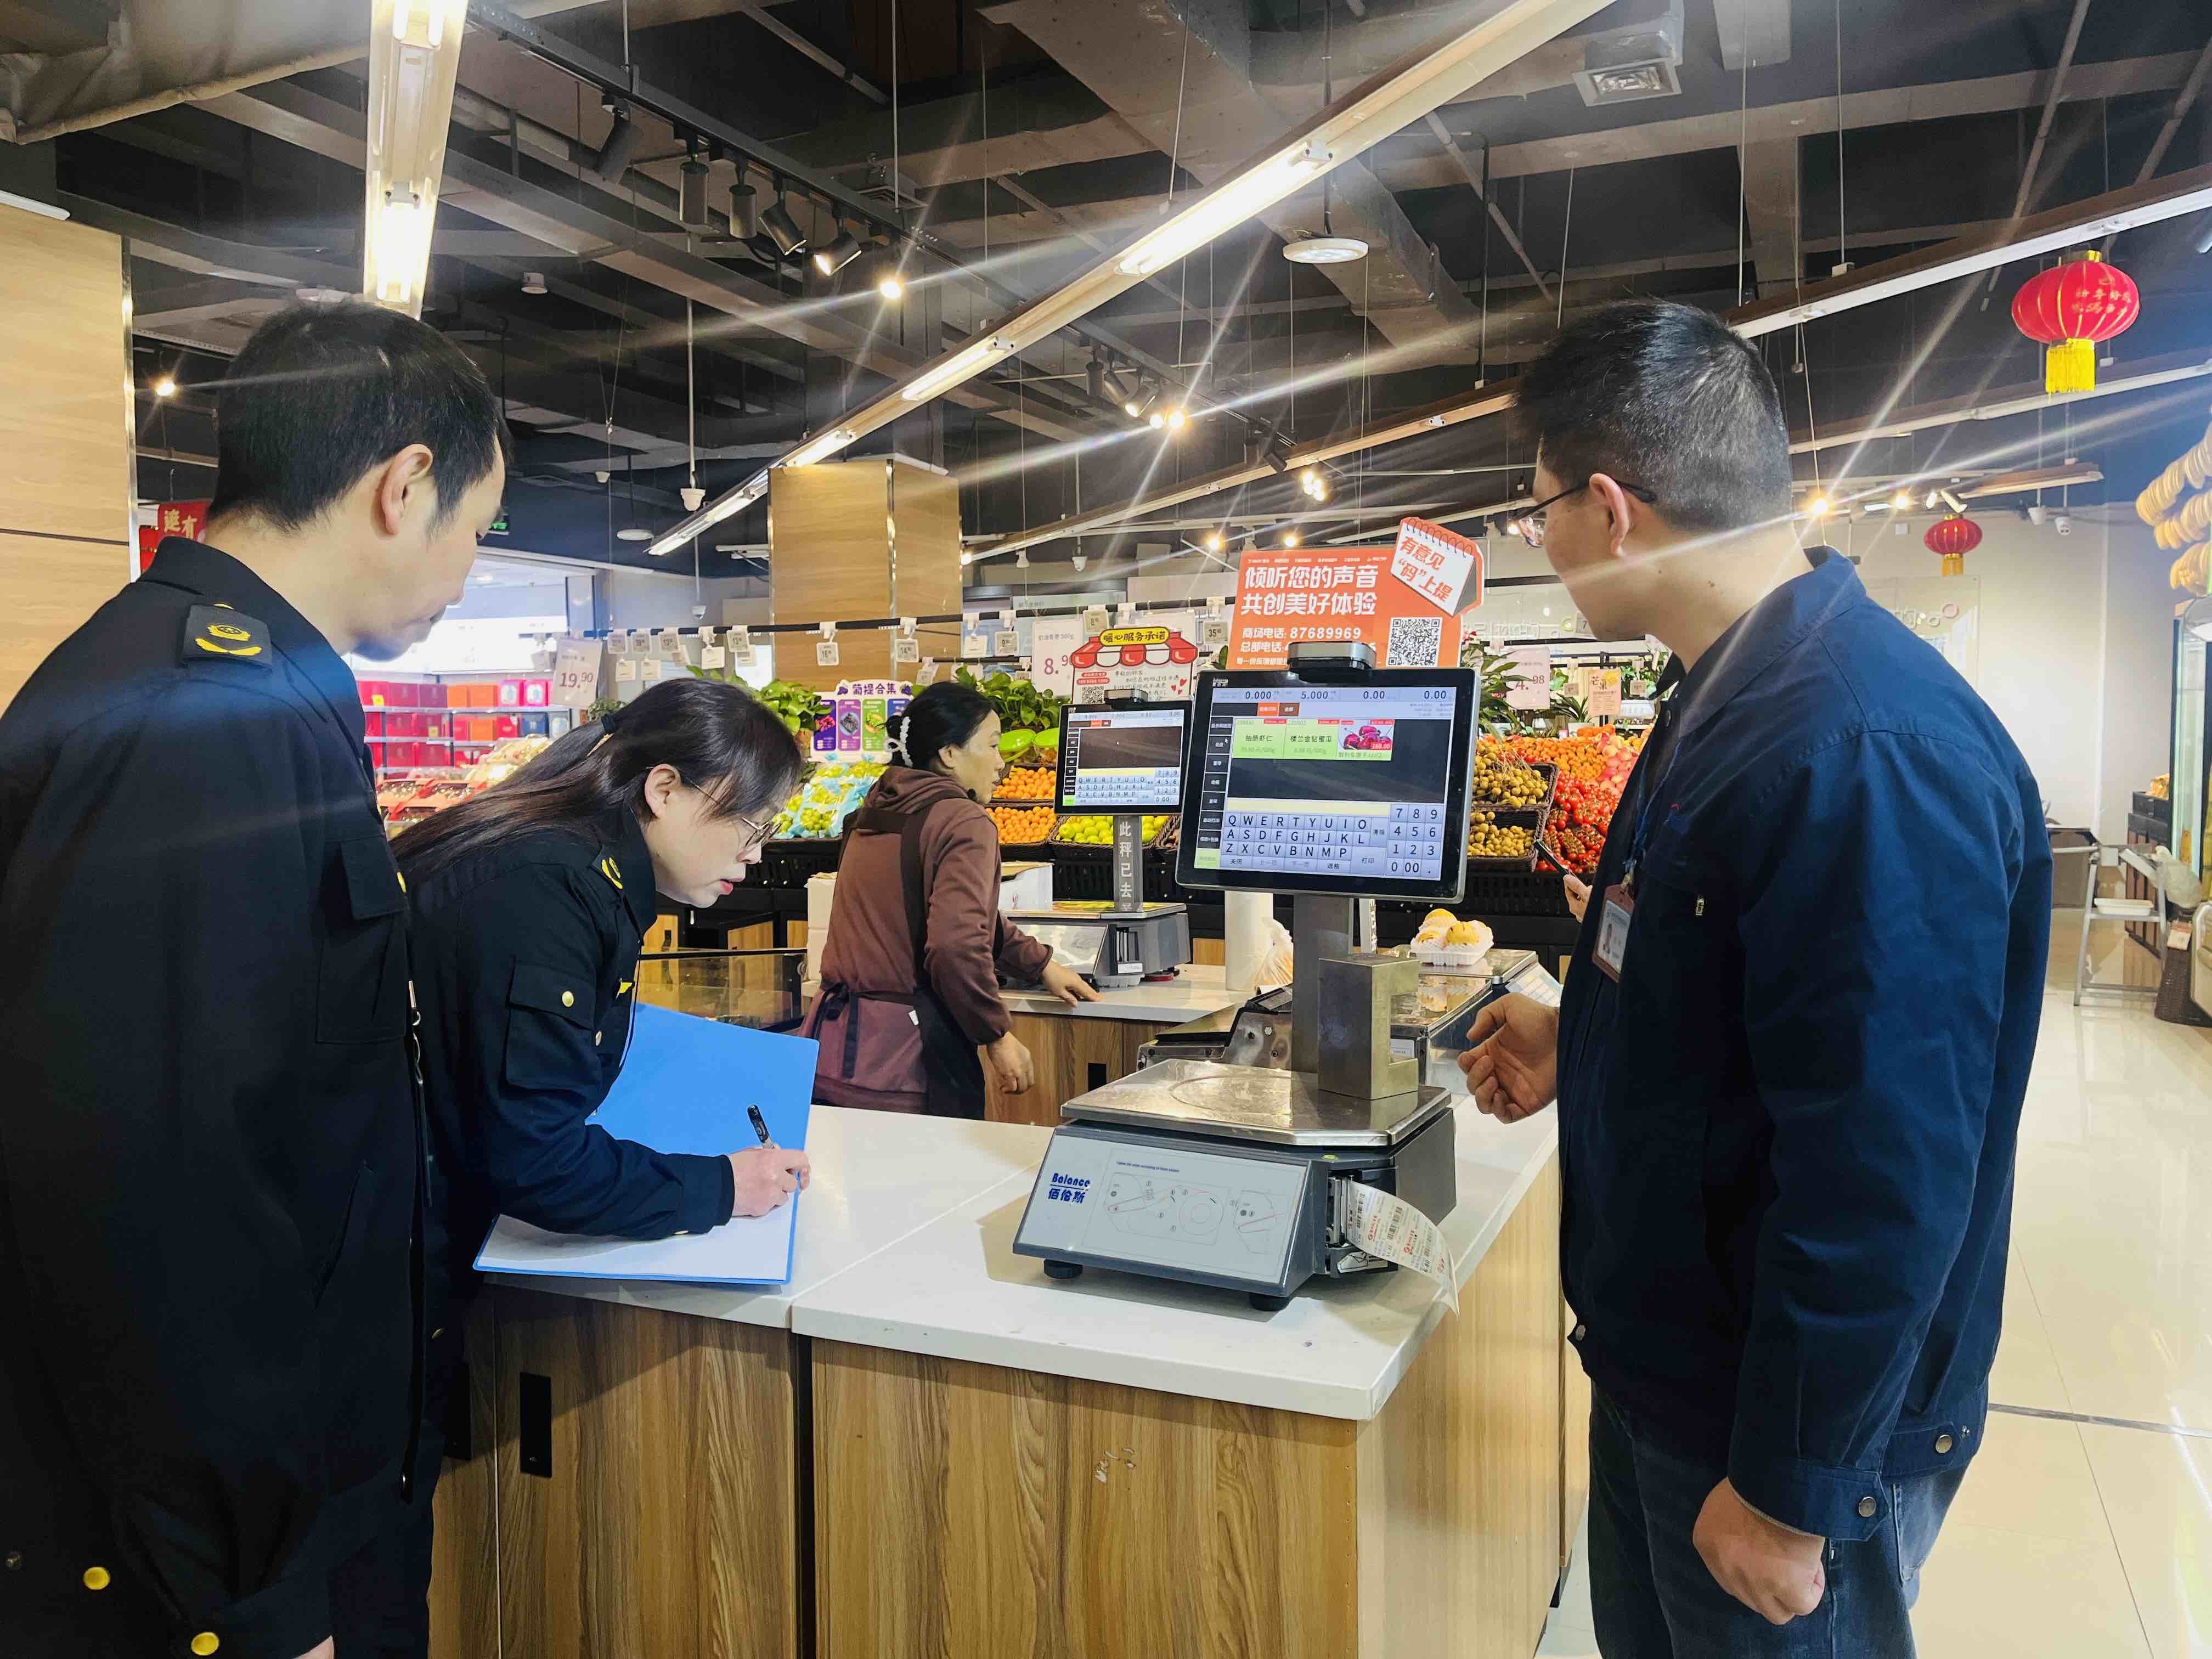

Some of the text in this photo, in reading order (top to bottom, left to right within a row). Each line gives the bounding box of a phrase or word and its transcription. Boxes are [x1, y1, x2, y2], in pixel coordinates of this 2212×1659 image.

[1401, 536, 1446, 571] 有意见
[1245, 565, 1379, 589] 倾听您的声音
[1240, 592, 1378, 616] 共创美好体验
[1103, 631, 1166, 643] 暖心服务承诺
[1289, 627, 1362, 639] 87689969
[559, 672, 594, 689] 19.90
[1245, 691, 1272, 699] 0.000
[1300, 691, 1329, 699] 5.000
[1363, 690, 1386, 699] 0.00
[1424, 690, 1447, 699] 0.00
[1396, 808, 1437, 819] 7 8 9
[1228, 815, 1237, 827] Q
[1243, 816, 1254, 825] W
[1261, 816, 1268, 826] E
[1277, 816, 1283, 826] R
[1293, 817, 1300, 827] T
[1309, 817, 1316, 827] Y
[1325, 819, 1333, 828] U
[1358, 820, 1366, 830] O
[1227, 829, 1234, 839] A
[1243, 830, 1250, 839] S
[1259, 831, 1266, 840] D
[1276, 831, 1282, 840] F
[1291, 831, 1298, 842] G
[1307, 832, 1315, 842] H
[1324, 833, 1330, 843] J
[1341, 833, 1348, 843] K
[1358, 834, 1364, 844] L
[1394, 826, 1436, 837] 4 5 6
[1226, 843, 1347, 857] Z X C V B N M P
[1393, 844, 1435, 856] 1 2 3
[1391, 862, 1398, 872] 0
[1404, 862, 1419, 873] 00
[1052, 1172, 1090, 1188] Balance
[1048, 1187, 1086, 1204] 佰伦斯
